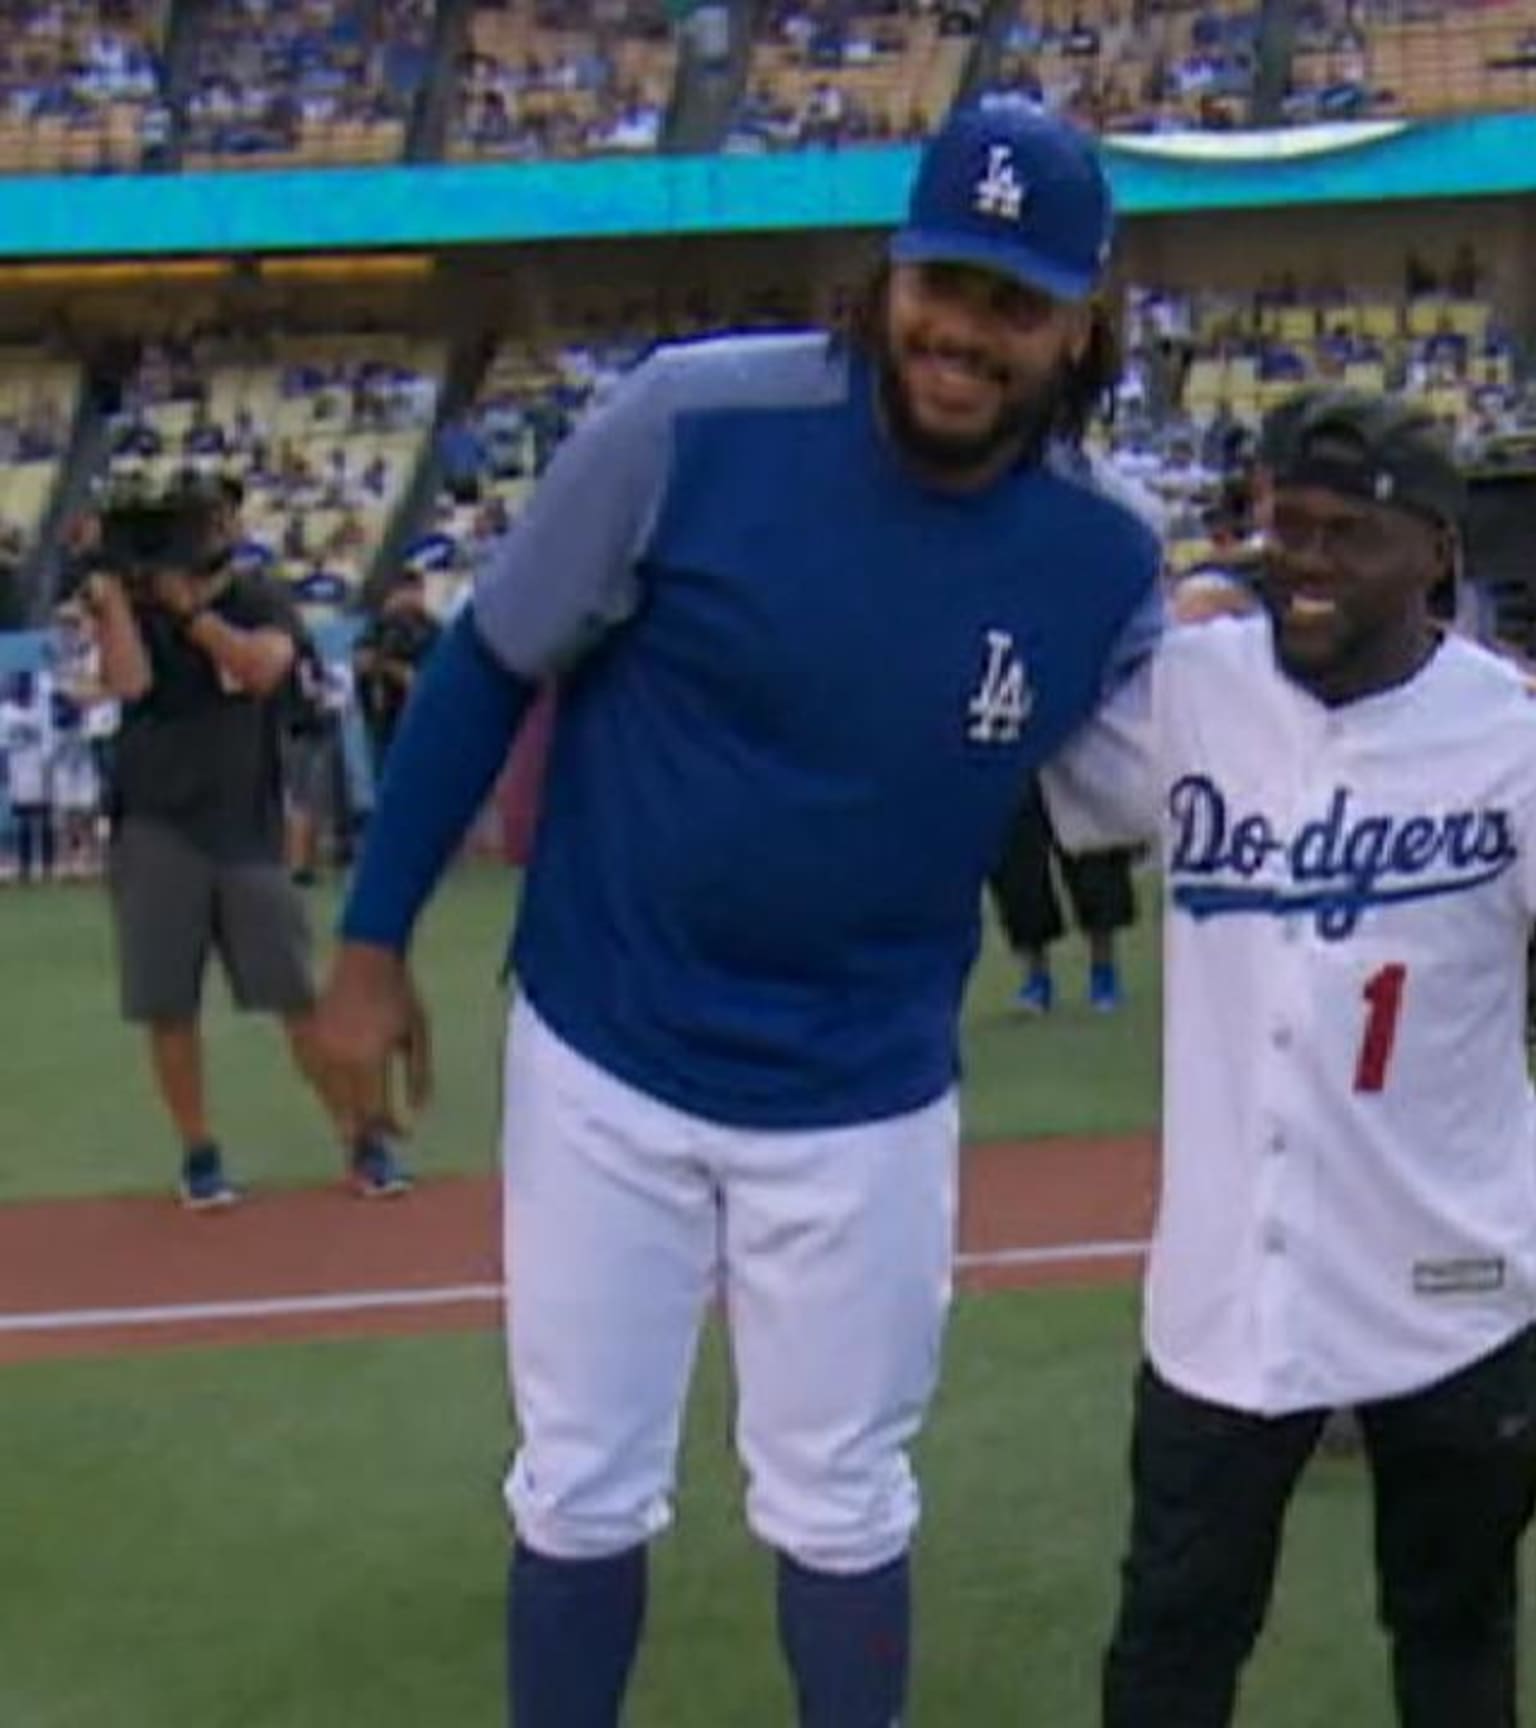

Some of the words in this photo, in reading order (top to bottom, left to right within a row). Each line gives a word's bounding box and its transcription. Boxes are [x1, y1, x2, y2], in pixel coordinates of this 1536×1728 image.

[977, 145, 1021, 219] LA
[969, 630, 1032, 741] LA
[1169, 774, 1517, 940] Dodgers
[1353, 962, 1406, 1093] 1
